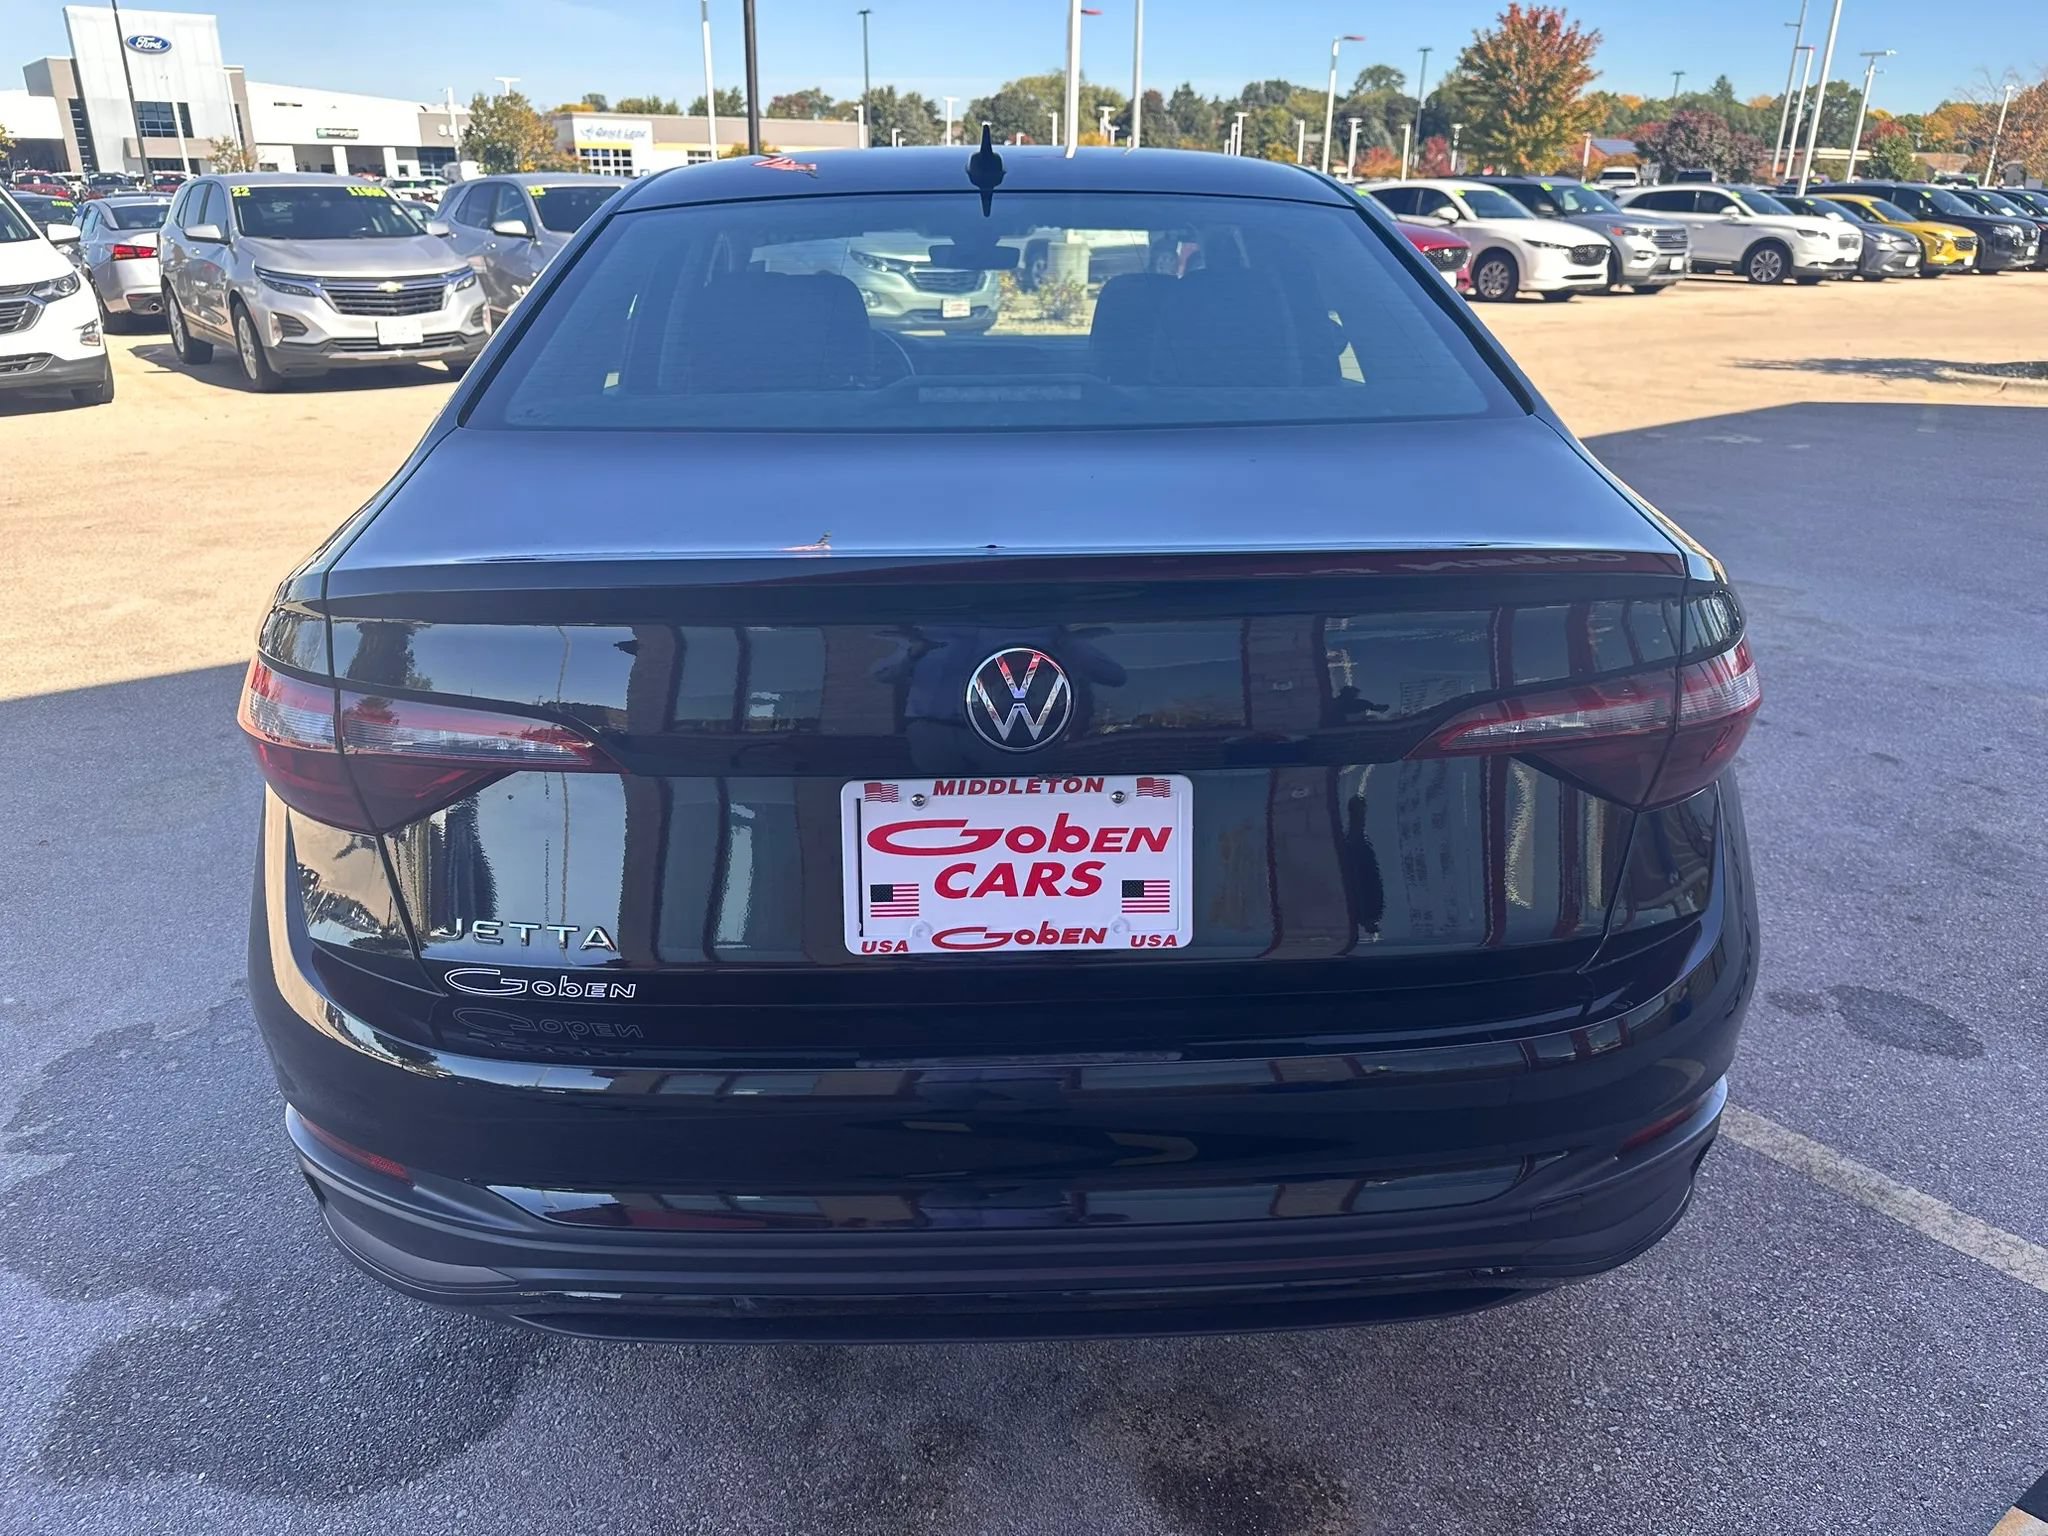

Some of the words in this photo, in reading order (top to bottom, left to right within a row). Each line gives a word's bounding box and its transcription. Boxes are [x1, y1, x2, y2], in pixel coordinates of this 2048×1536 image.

[136, 36, 162, 49] Ford
[932, 776, 1105, 797] MIDDLETON
[933, 861, 1106, 899] CARS
[434, 917, 617, 952] JETTA
[1129, 934, 1178, 949] USA
[861, 939, 909, 954] USA
